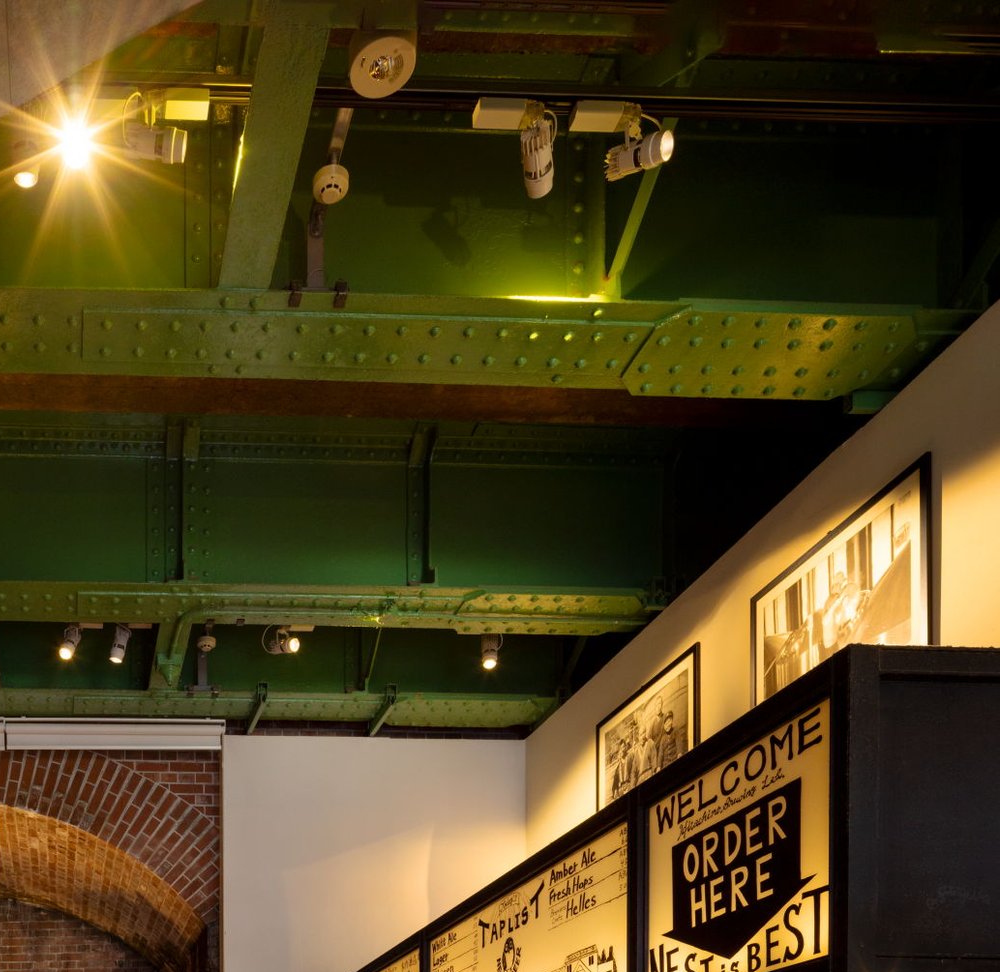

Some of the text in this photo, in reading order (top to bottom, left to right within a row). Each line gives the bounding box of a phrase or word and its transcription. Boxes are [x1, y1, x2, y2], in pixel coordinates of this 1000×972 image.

[656, 706, 823, 835] WELCOME
[683, 794, 787, 883] ORDER
[550, 861, 579, 886] Amber
[581, 847, 597, 868] Ale
[572, 875, 594, 894] Hops
[690, 852, 774, 928] HERE
[478, 879, 545, 948] TAPLIST
[565, 892, 597, 919] Helles
[432, 953, 448, 967] Lager
